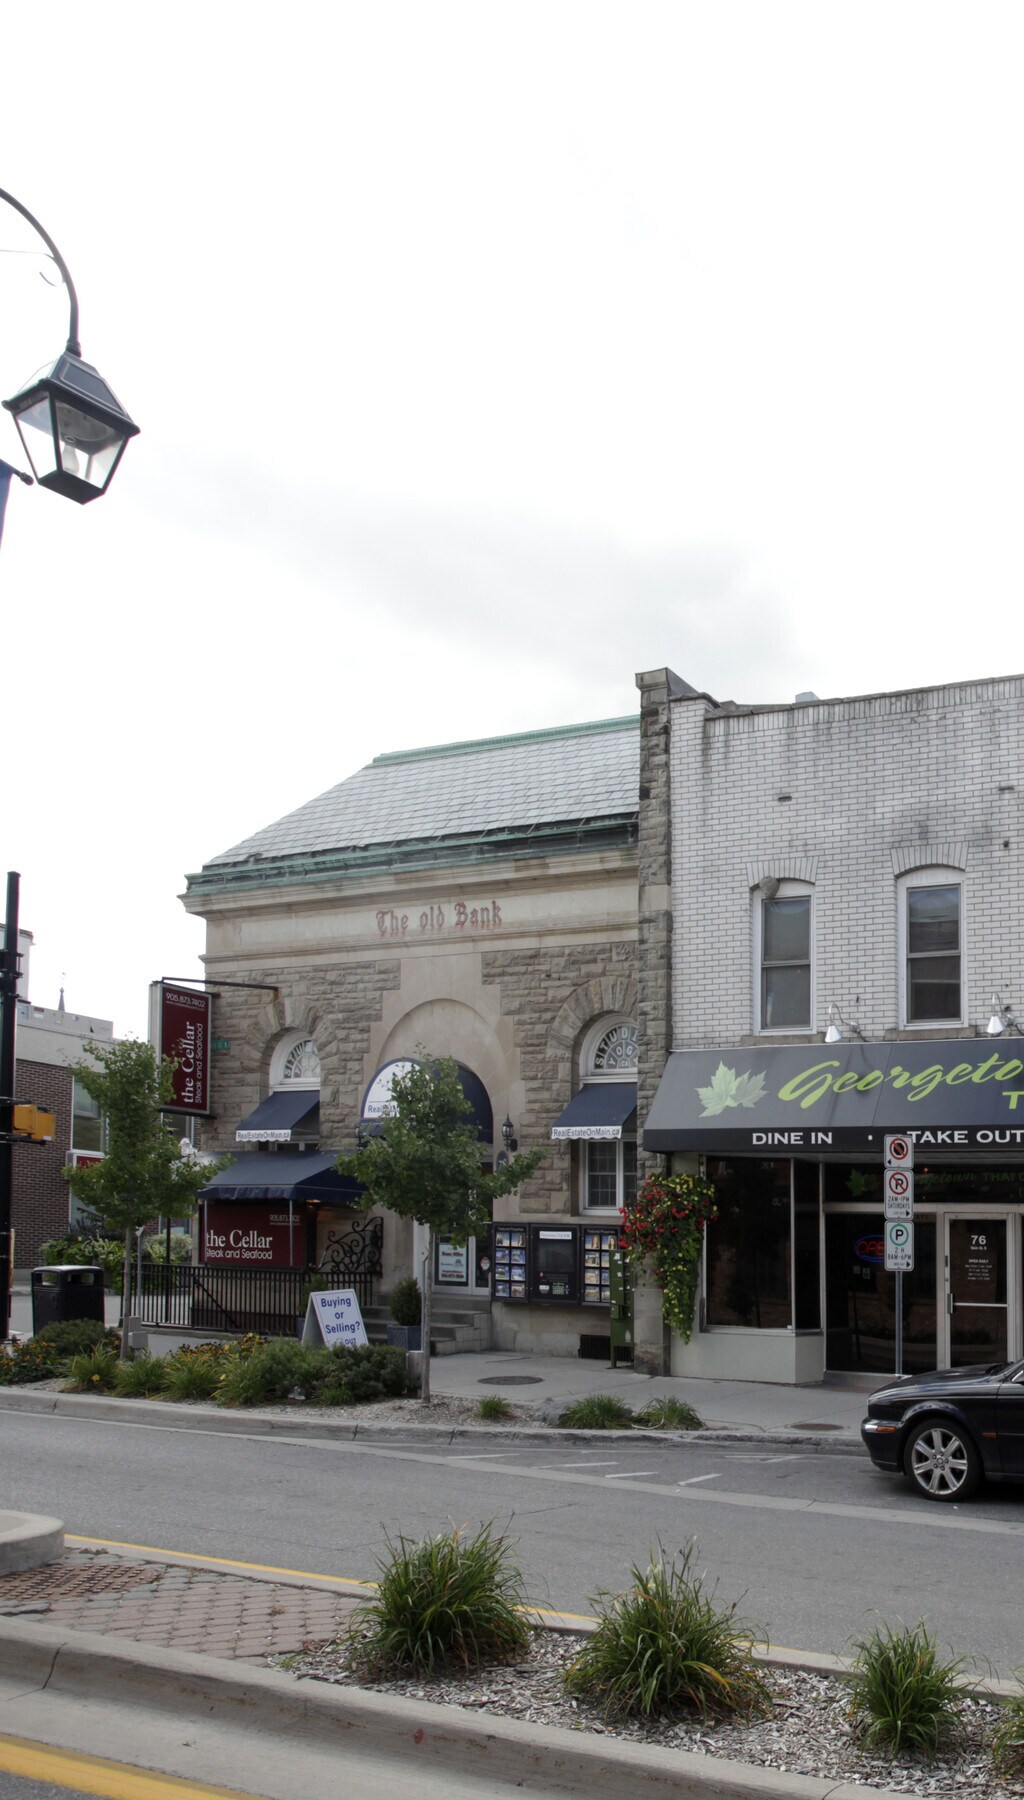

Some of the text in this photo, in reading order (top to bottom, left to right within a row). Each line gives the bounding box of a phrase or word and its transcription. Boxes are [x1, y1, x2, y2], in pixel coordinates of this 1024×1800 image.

[376, 909, 409, 935] The
[454, 899, 503, 929] Bank
[196, 1023, 204, 1060] Seafood
[181, 1021, 195, 1103] the Cellar
[195, 1080, 203, 1104] Steak
[237, 1131, 290, 1140] RealEstateOnMain.ca
[553, 1128, 620, 1137] RealEstateOnMain.ca
[752, 1132, 804, 1145] DINE
[811, 1131, 833, 1145] IN
[906, 1130, 968, 1145] TAKE
[206, 1229, 273, 1248] the Cellar
[970, 1235, 986, 1245] 76
[225, 1249, 240, 1258] and
[242, 1248, 272, 1260] Seafood
[320, 1297, 352, 1309] Buying
[334, 1312, 344, 1320] or
[325, 1320, 361, 1334] Selling?
